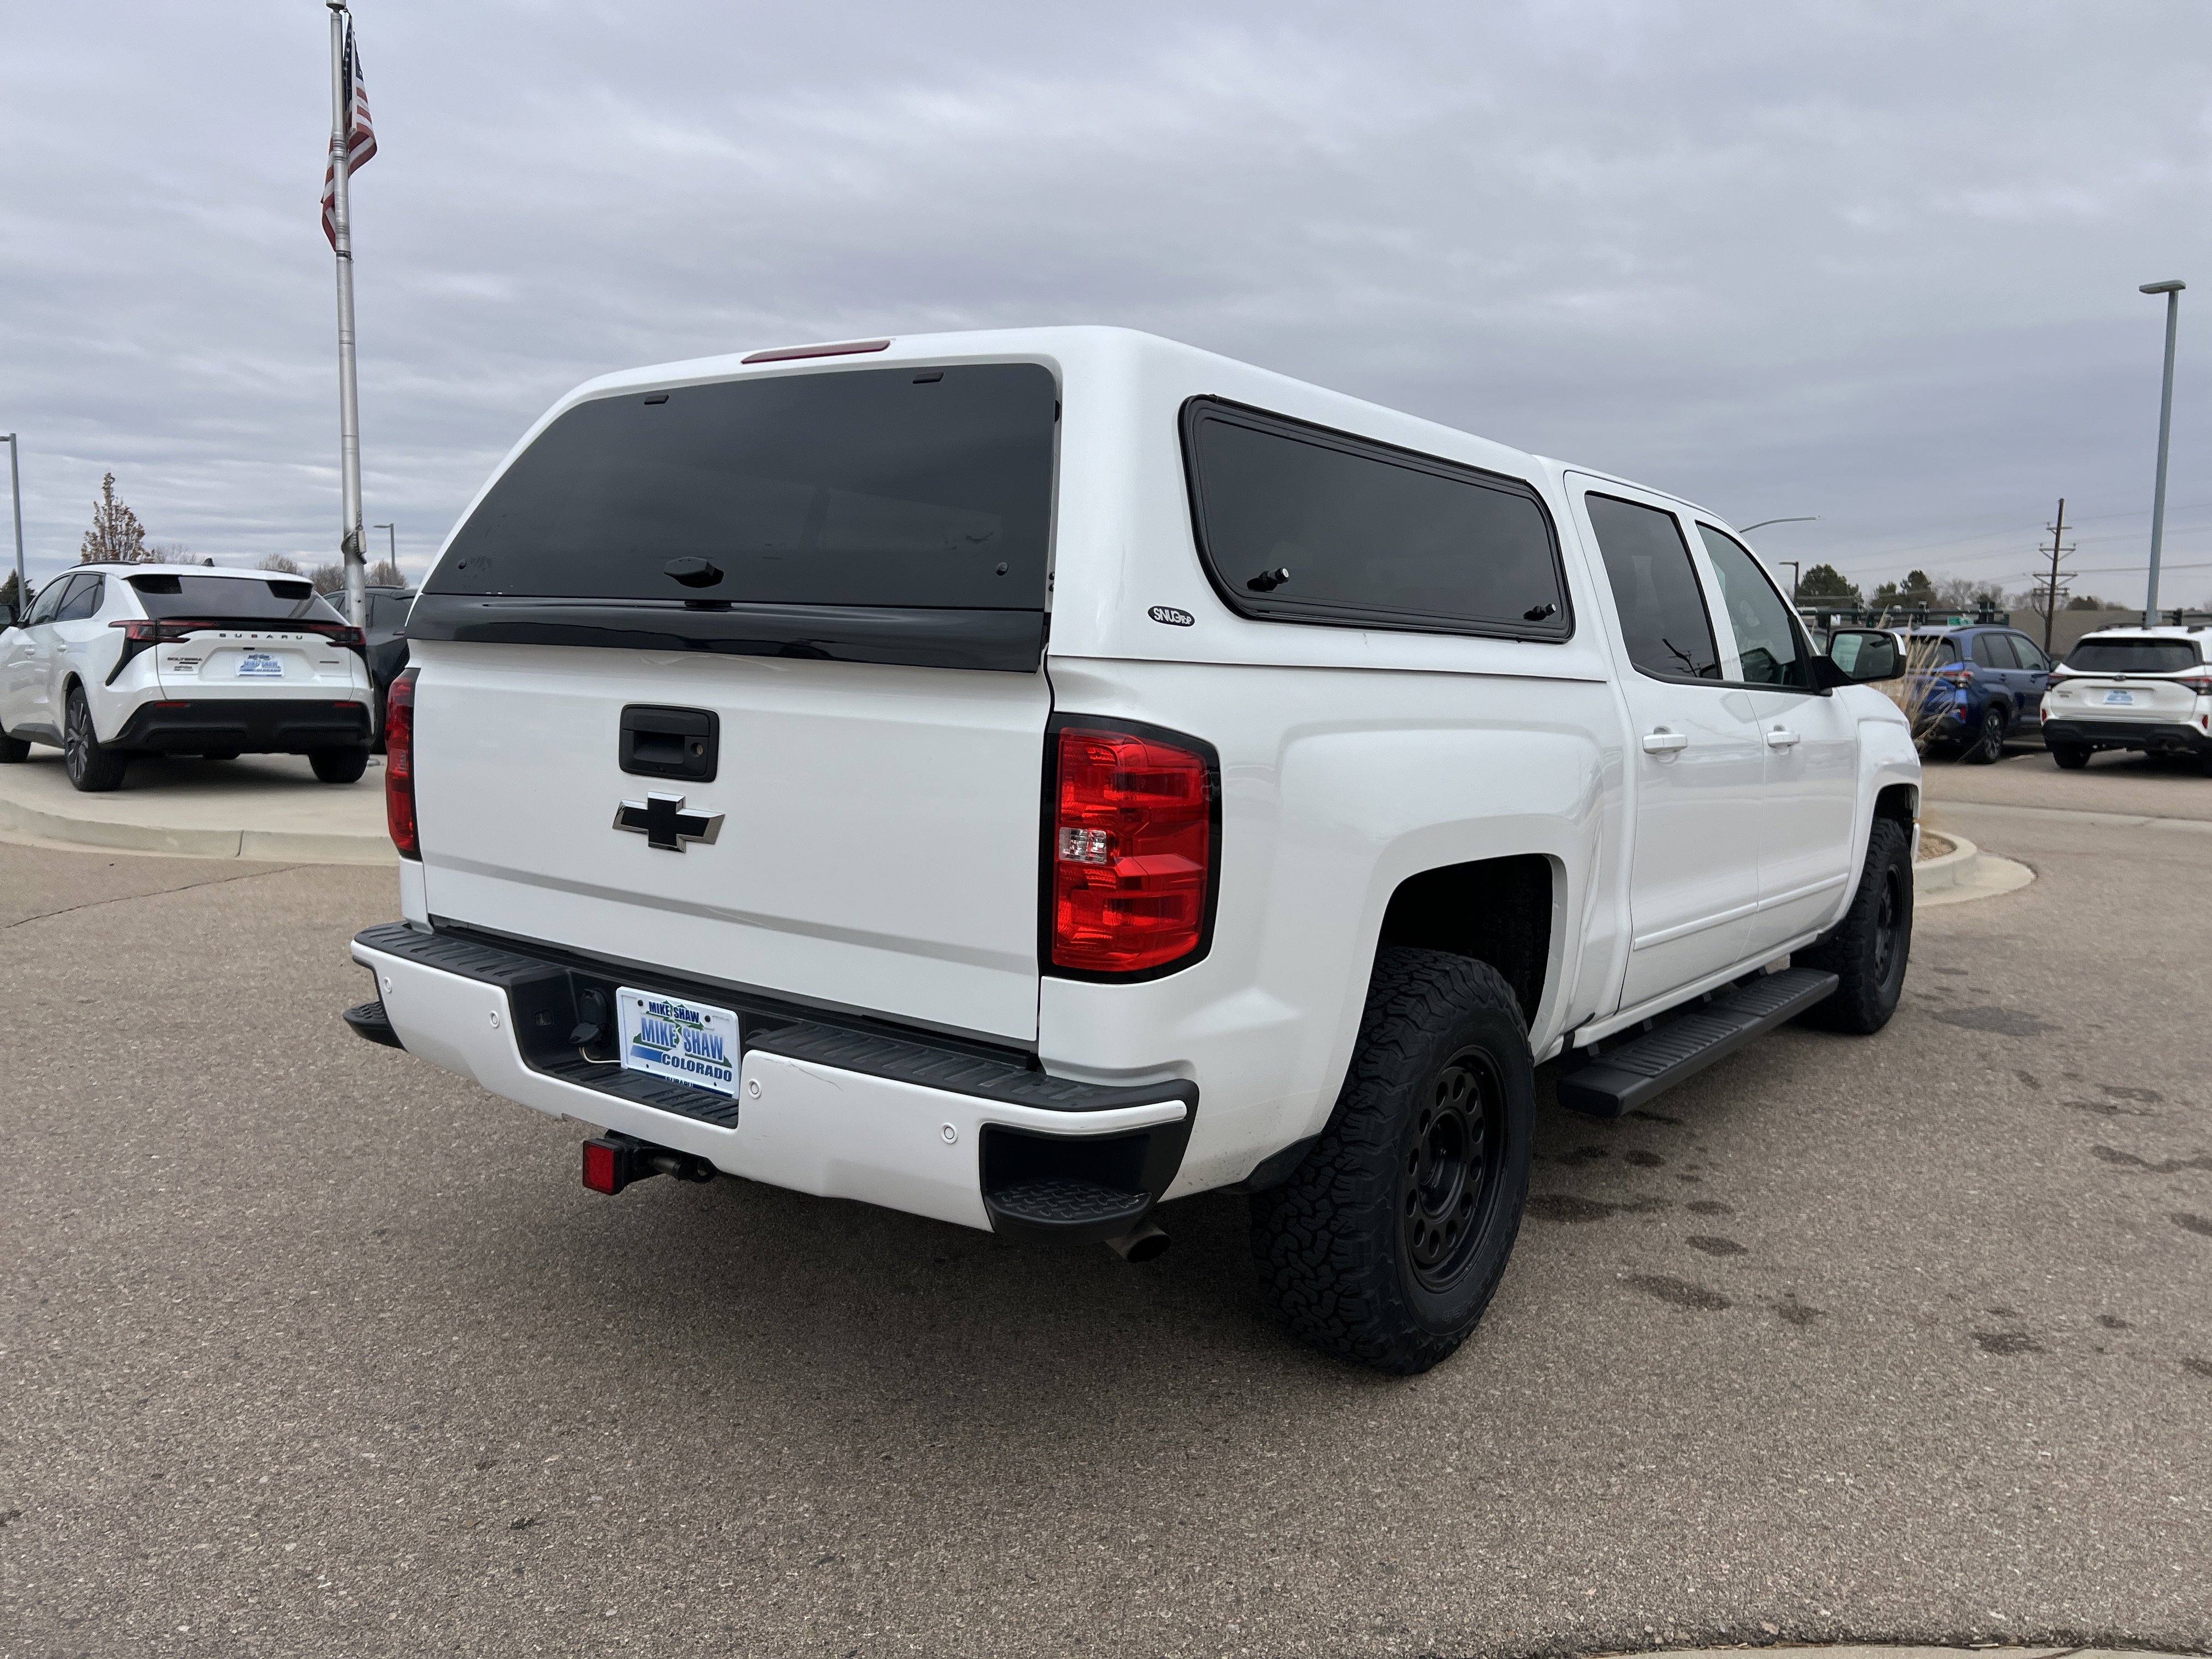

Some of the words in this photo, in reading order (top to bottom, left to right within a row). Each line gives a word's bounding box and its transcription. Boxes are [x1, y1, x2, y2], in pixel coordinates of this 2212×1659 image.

[648, 1001, 670, 1016] MIKE
[673, 1006, 699, 1023] SHAW
[641, 1017, 677, 1048] MIKE
[683, 1027, 723, 1061] SHAW
[661, 1053, 732, 1082] COLORADO
